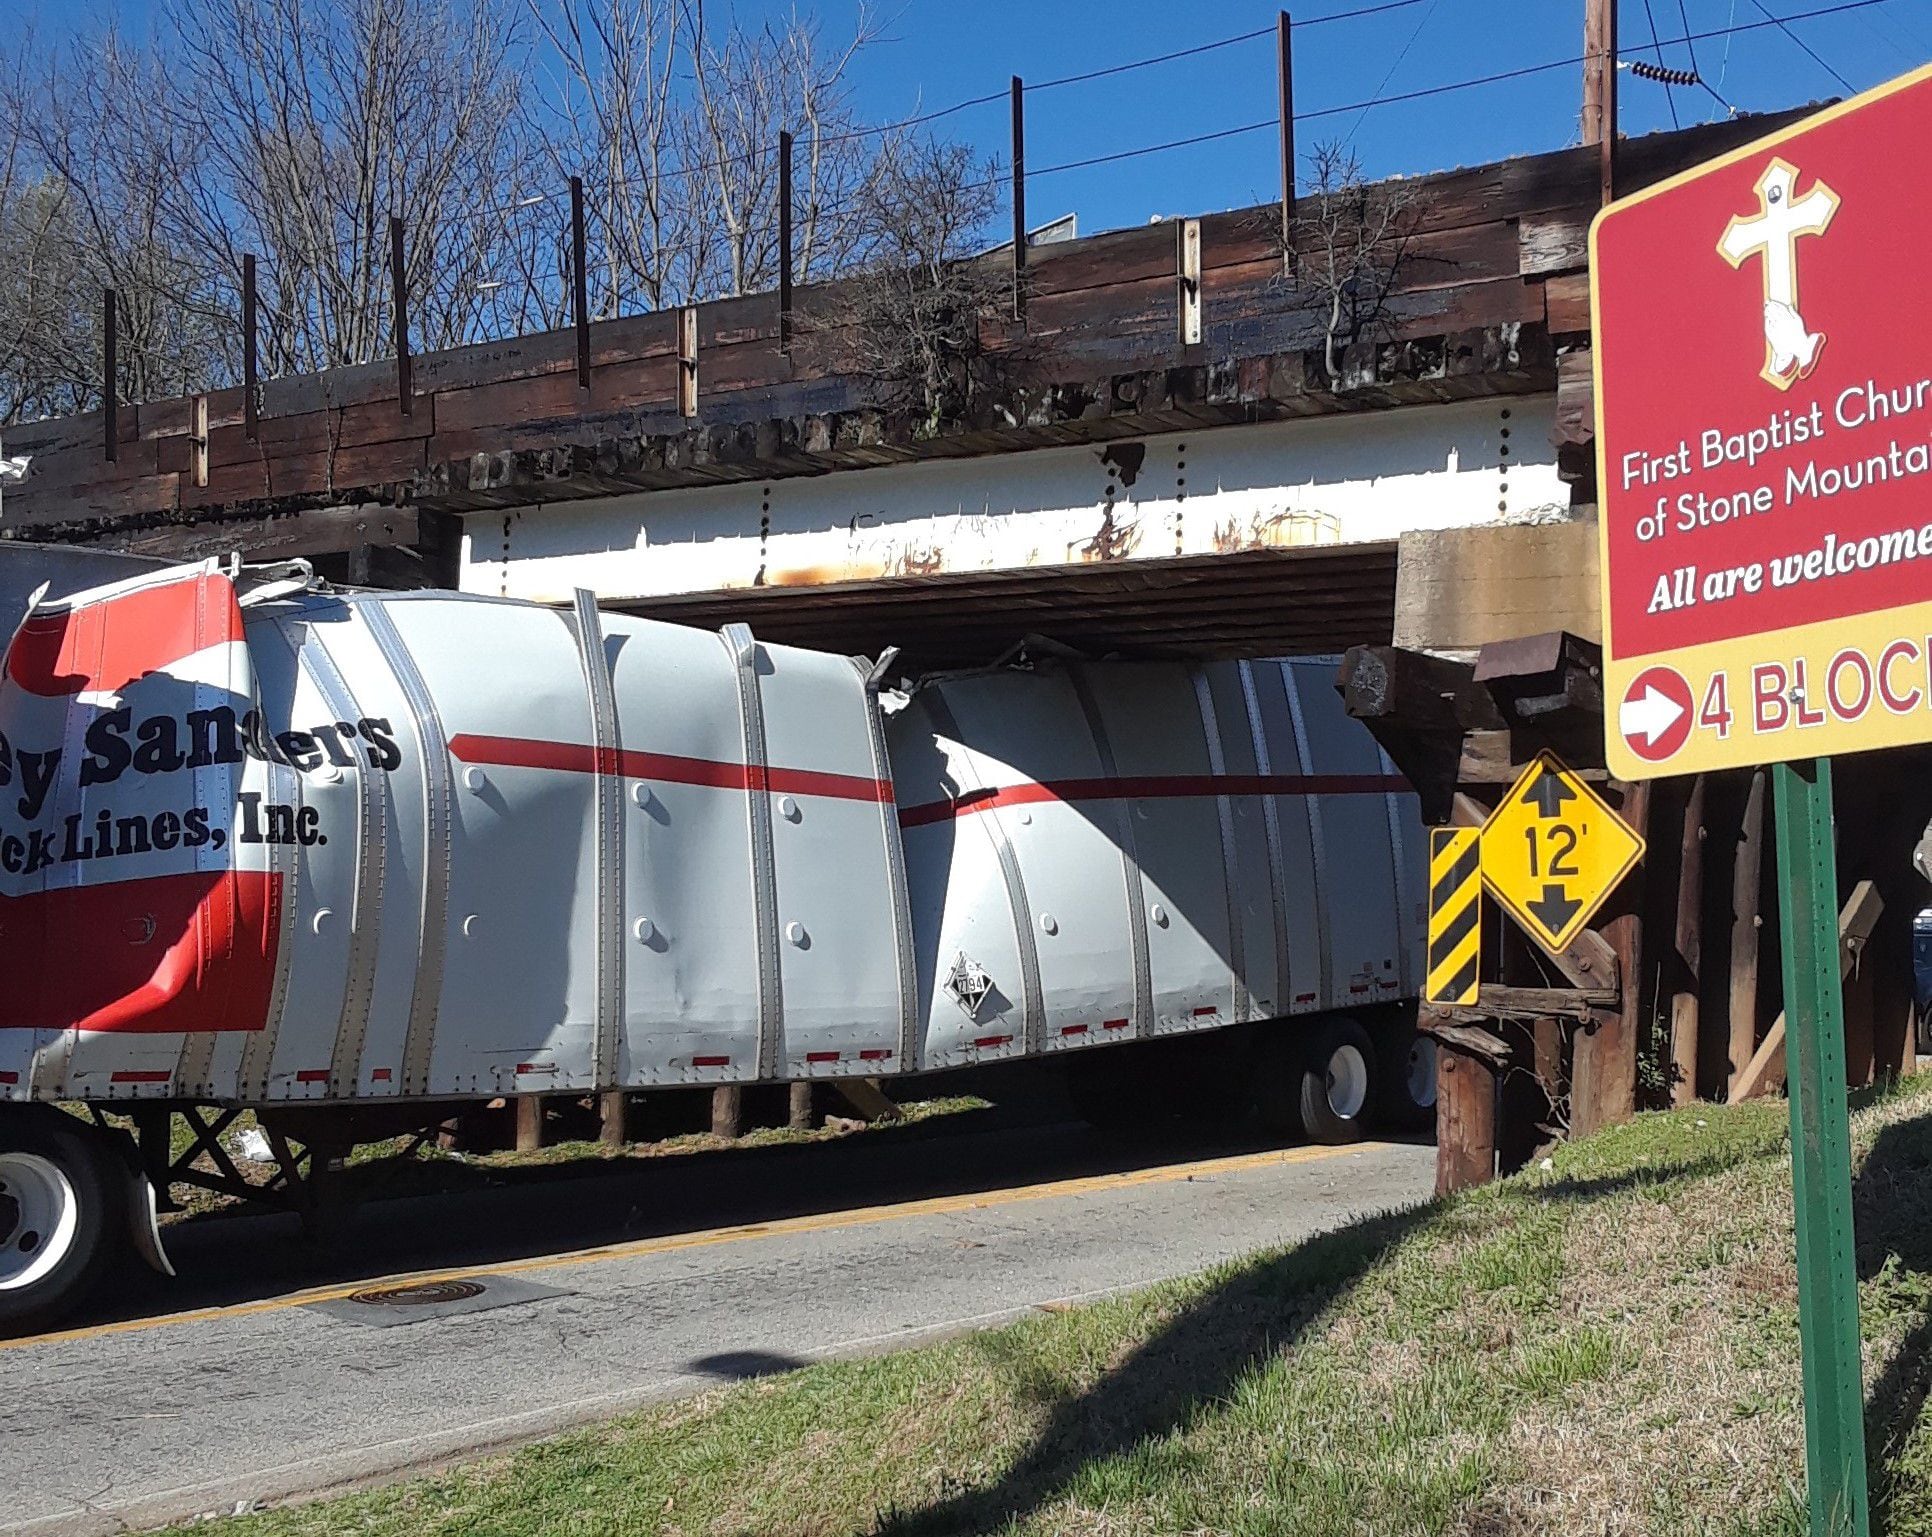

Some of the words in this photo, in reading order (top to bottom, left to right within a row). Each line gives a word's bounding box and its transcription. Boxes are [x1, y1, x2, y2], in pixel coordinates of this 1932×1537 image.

[1622, 440, 1692, 490] First
[1702, 400, 1824, 468] Baptist
[1835, 379, 1932, 428] Chur
[1636, 497, 1667, 541] of
[1676, 486, 1773, 531] Stone
[1646, 565, 1698, 613] All
[1702, 562, 1763, 602] are
[1769, 524, 1932, 589] welcome
[1699, 670, 1734, 740] 4
[79, 704, 402, 788] Sanders
[0, 826, 56, 875] ck
[60, 805, 226, 863] Lines,
[238, 791, 328, 846] Inc.
[1524, 823, 1588, 877] 12'
[958, 976, 983, 994] 2794
